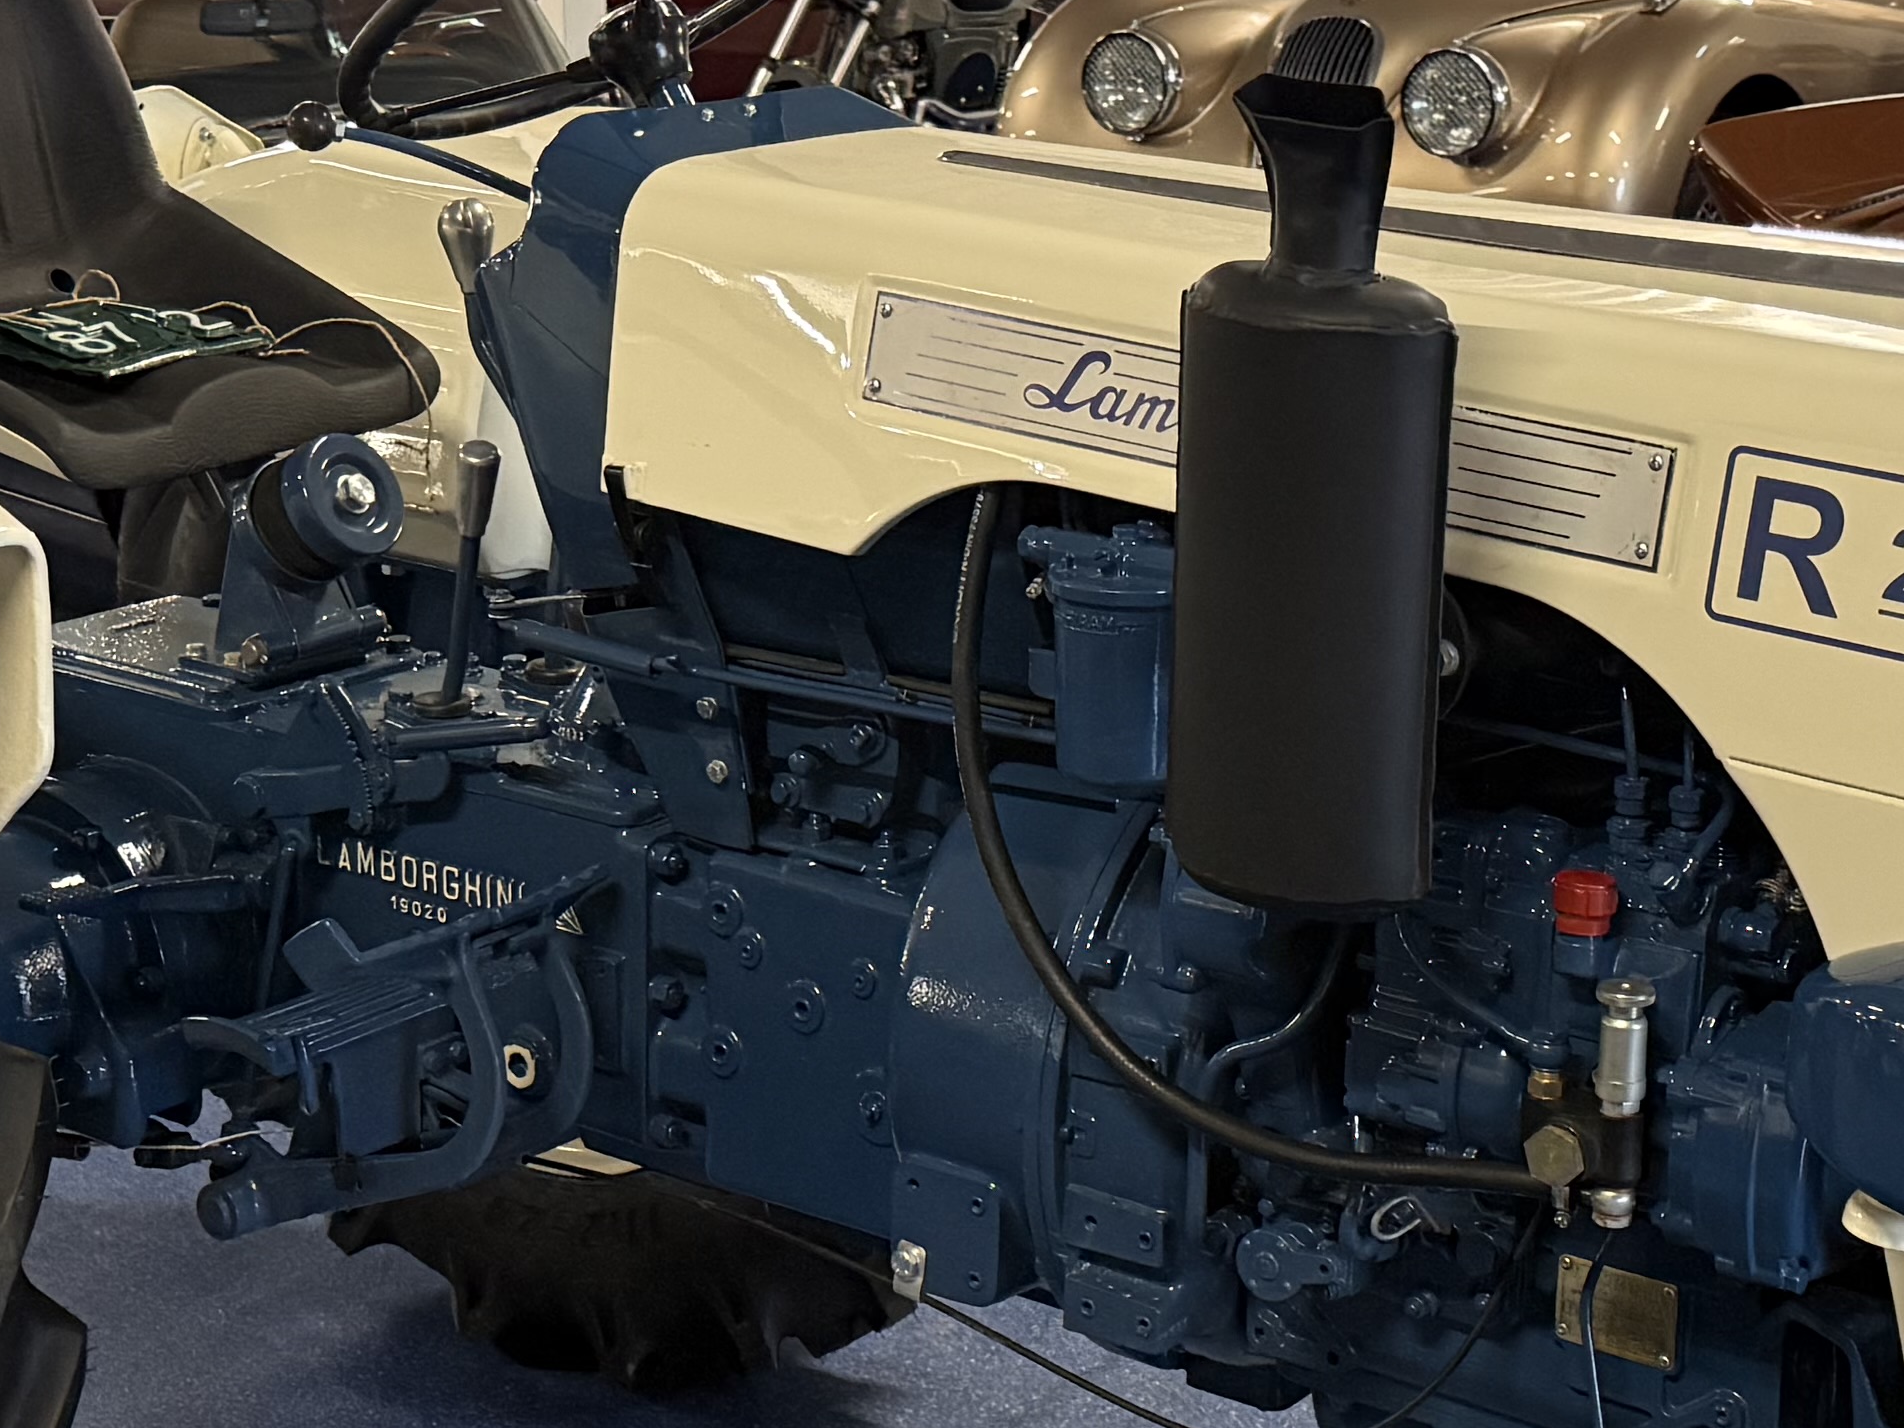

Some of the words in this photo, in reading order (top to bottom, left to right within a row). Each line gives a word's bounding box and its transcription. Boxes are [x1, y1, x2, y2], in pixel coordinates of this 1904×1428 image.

[1022, 350, 1179, 433] Lam
[1736, 475, 1845, 619] R
[389, 894, 447, 923] 19020
